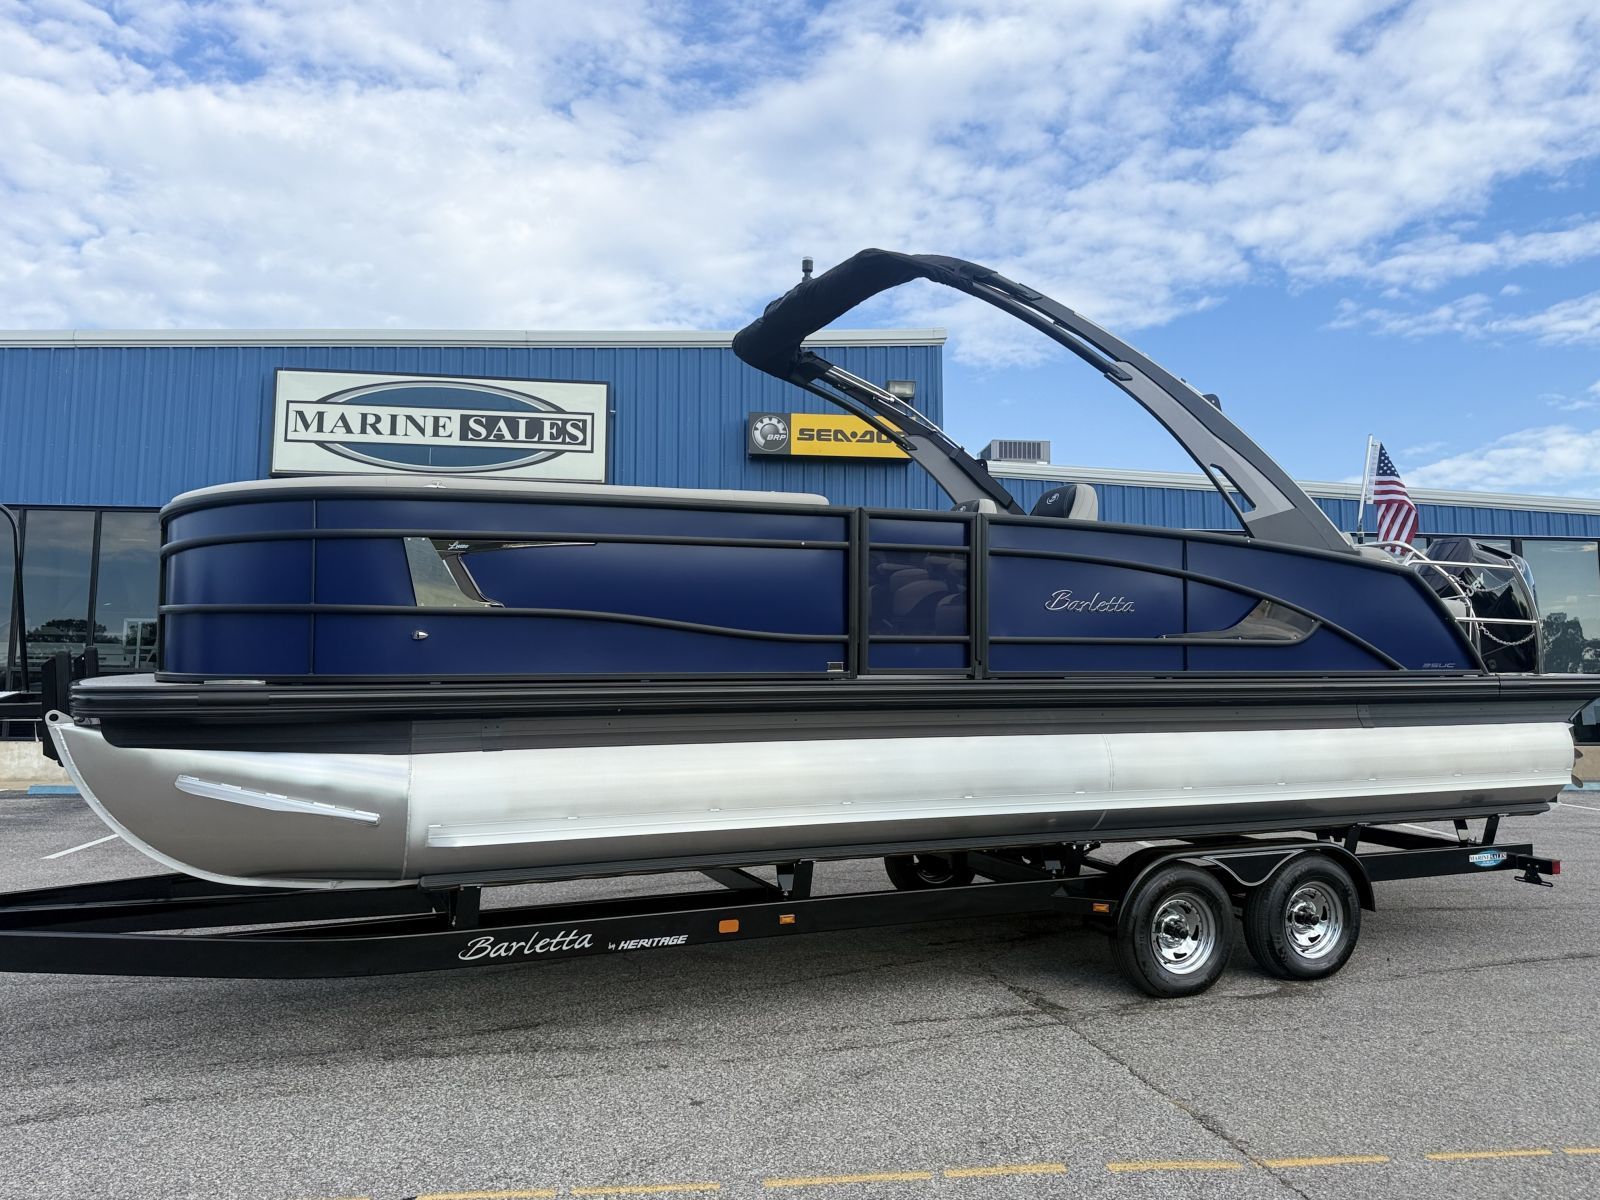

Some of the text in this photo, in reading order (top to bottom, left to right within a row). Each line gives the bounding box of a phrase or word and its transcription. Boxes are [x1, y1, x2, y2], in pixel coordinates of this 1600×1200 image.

[292, 409, 584, 444] MARINE SALES
[1044, 589, 1135, 612] Barletta
[458, 929, 593, 961] Barletta
[618, 934, 689, 951] HERITAGE
